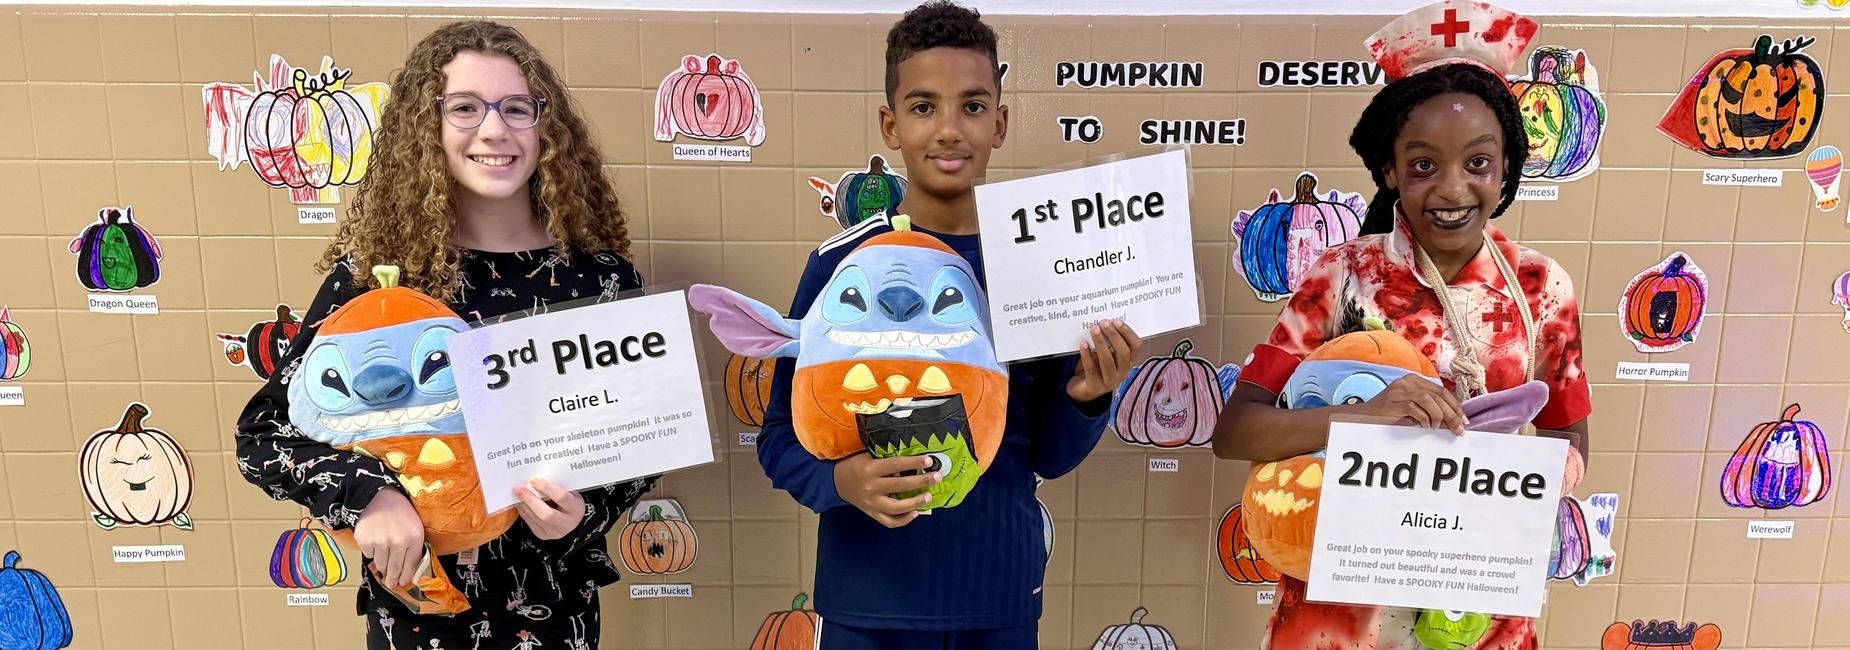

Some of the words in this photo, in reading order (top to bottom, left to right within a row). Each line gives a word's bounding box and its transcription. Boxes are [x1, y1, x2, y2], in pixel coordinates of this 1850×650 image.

[1057, 62, 1203, 87] PUMPKIN
[1259, 61, 1391, 86] DESERV
[1059, 118, 1101, 142] TO
[1140, 119, 1246, 144] SHINE!
[674, 146, 706, 156] Queen
[707, 147, 718, 156] of
[720, 148, 750, 157] Hearts
[1705, 172, 1730, 184] Scary
[1731, 173, 1778, 184] Superhero
[1518, 188, 1556, 197] Princess
[300, 210, 334, 221] Dragon
[1011, 199, 1059, 244] 1st
[1071, 191, 1165, 234] Place
[1054, 250, 1123, 275] Chandler
[1126, 246, 1136, 261] J.
[1002, 302, 1028, 312] Great
[1029, 299, 1044, 310] job
[1046, 298, 1058, 306] on
[1059, 295, 1080, 305] your
[1081, 287, 1119, 301] aquarium
[1120, 277, 1153, 294] pumpkin!
[1155, 275, 1170, 283] You
[1171, 271, 1184, 280] are
[89, 298, 123, 309] Dragon
[125, 299, 157, 309] Queen
[1009, 315, 1047, 326] creative,
[1048, 310, 1071, 320] kind,
[1072, 306, 1089, 316] and
[1090, 302, 1108, 313] fun!
[1110, 299, 1129, 309] Have
[1134, 289, 1164, 304] SPOOKY
[1165, 286, 1182, 296] FUN
[482, 339, 538, 390] 3rd
[552, 331, 667, 375] Place
[1618, 366, 1648, 376] Horror
[1649, 367, 1688, 378] Pumpkin
[0, 392, 23, 400] ueen
[549, 394, 599, 414] Claire
[604, 389, 619, 404] L.
[487, 446, 511, 460] Great
[512, 442, 527, 454] job
[529, 440, 542, 448] on
[543, 435, 564, 447] your
[566, 428, 605, 442] skeleton
[607, 417, 650, 435] pumpkin!
[654, 416, 661, 424] It
[662, 413, 681, 422] was
[682, 410, 693, 419] so
[741, 435, 756, 443] Sca
[506, 459, 522, 469] fun
[523, 453, 542, 464] and
[543, 446, 584, 461] creative!
[588, 442, 611, 453] Have
[612, 440, 619, 448] a
[620, 431, 656, 446] SPOOKY
[658, 427, 677, 438] FUN
[570, 453, 622, 471] Halloween!
[1151, 460, 1177, 470] Witch
[1338, 451, 1419, 490] 2nd
[1431, 456, 1546, 500] Place
[1400, 511, 1447, 530] Alicia
[1451, 515, 1464, 531] J.
[1750, 525, 1792, 534] Werewolf
[114, 549, 143, 559] Happy
[145, 548, 184, 558] Pumpkin
[1326, 543, 1352, 553] Great
[1352, 544, 1368, 554] job
[1369, 546, 1382, 554] on
[1383, 548, 1404, 556] your
[1405, 549, 1439, 560] spooky
[1440, 552, 1487, 562] superhero
[1488, 554, 1533, 566] pumpkin!
[1339, 558, 1346, 567] It
[1348, 559, 1379, 569] turned
[1380, 562, 1396, 570] out
[1397, 562, 1439, 573] beautiful
[1440, 566, 1458, 575] and
[1459, 568, 1477, 576] was
[1487, 570, 1516, 579] crowd
[631, 587, 659, 596] Candy
[661, 586, 690, 595] Bucket
[1332, 572, 1370, 583] favorite!
[1374, 575, 1397, 585] Have
[1398, 578, 1404, 586] a
[1406, 578, 1444, 589] SPOOKY
[1445, 581, 1465, 590] FUN
[1466, 582, 1519, 595] Halloween!
[289, 595, 328, 604] Rainbow
[1260, 592, 1274, 601] Mo
